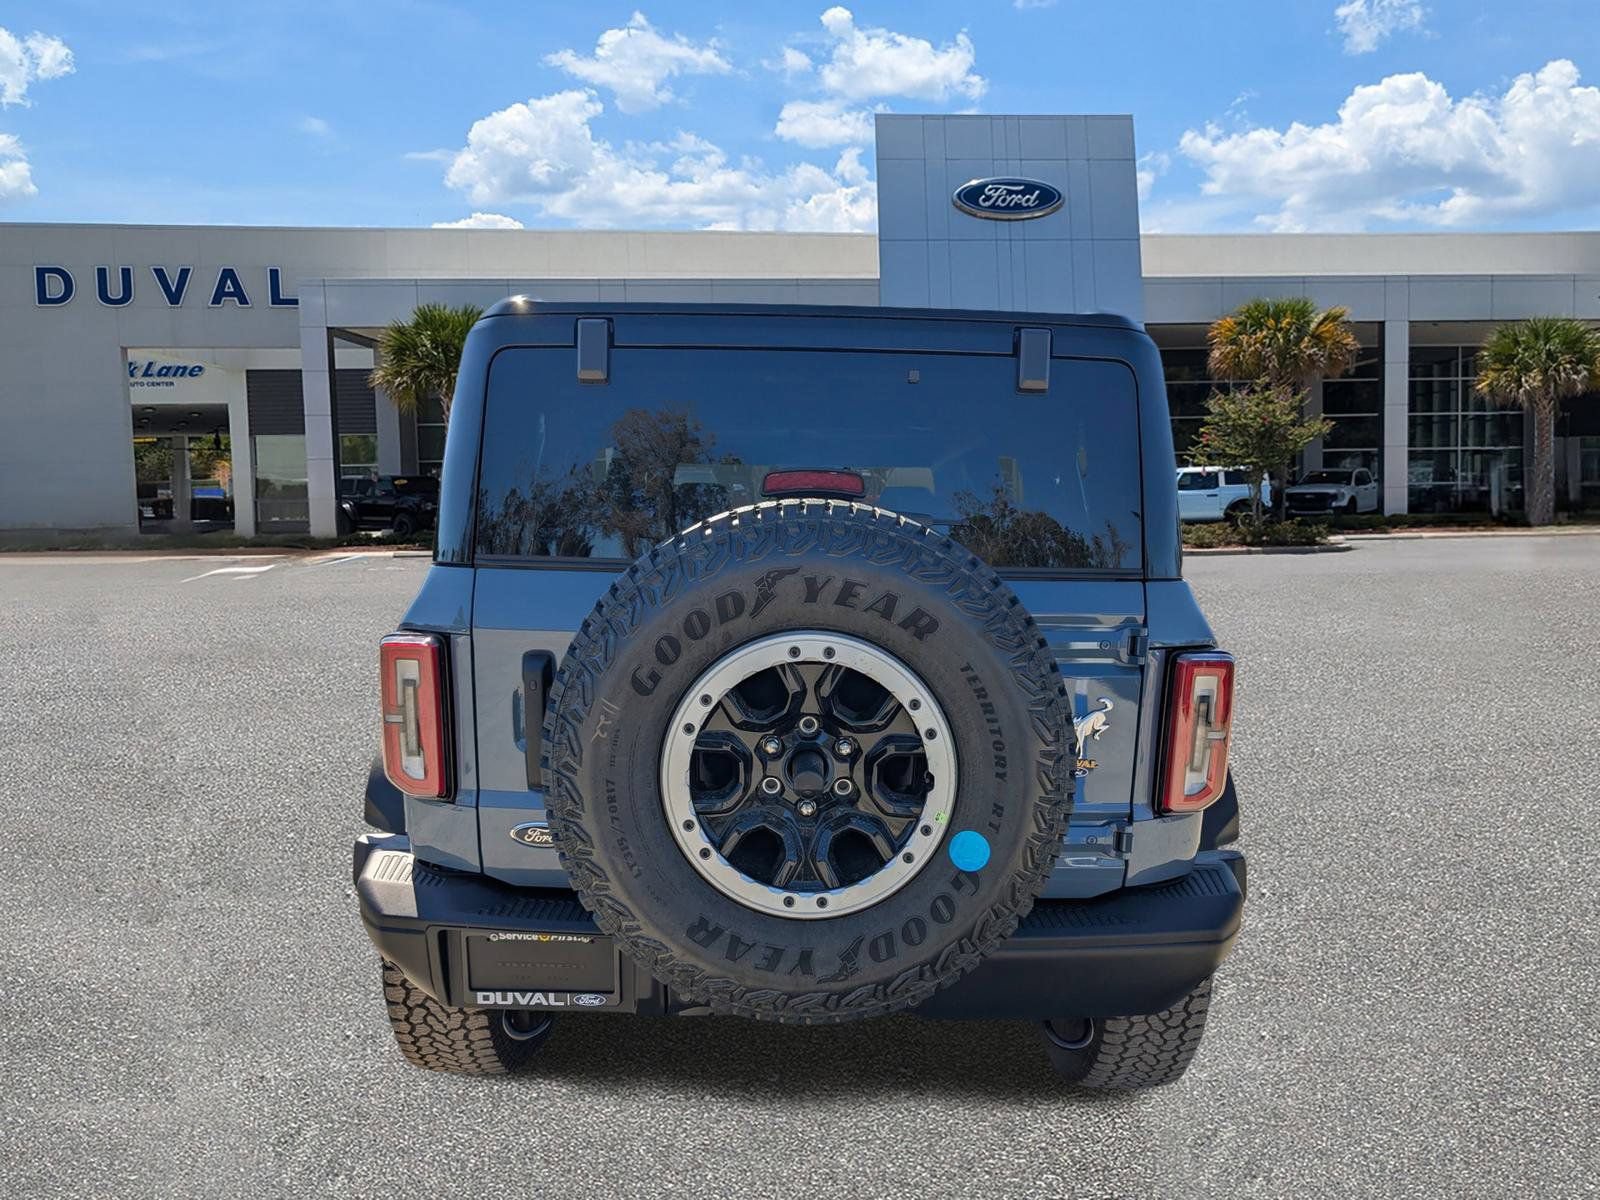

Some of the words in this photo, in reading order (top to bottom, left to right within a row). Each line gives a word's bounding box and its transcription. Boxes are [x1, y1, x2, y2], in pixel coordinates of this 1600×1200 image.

[33, 265, 299, 308] DUVAL
[142, 361, 205, 378] Lane
[960, 662, 1008, 784] TERRITORY
[988, 802, 1004, 834] RT
[476, 992, 565, 1006] DUVAL
